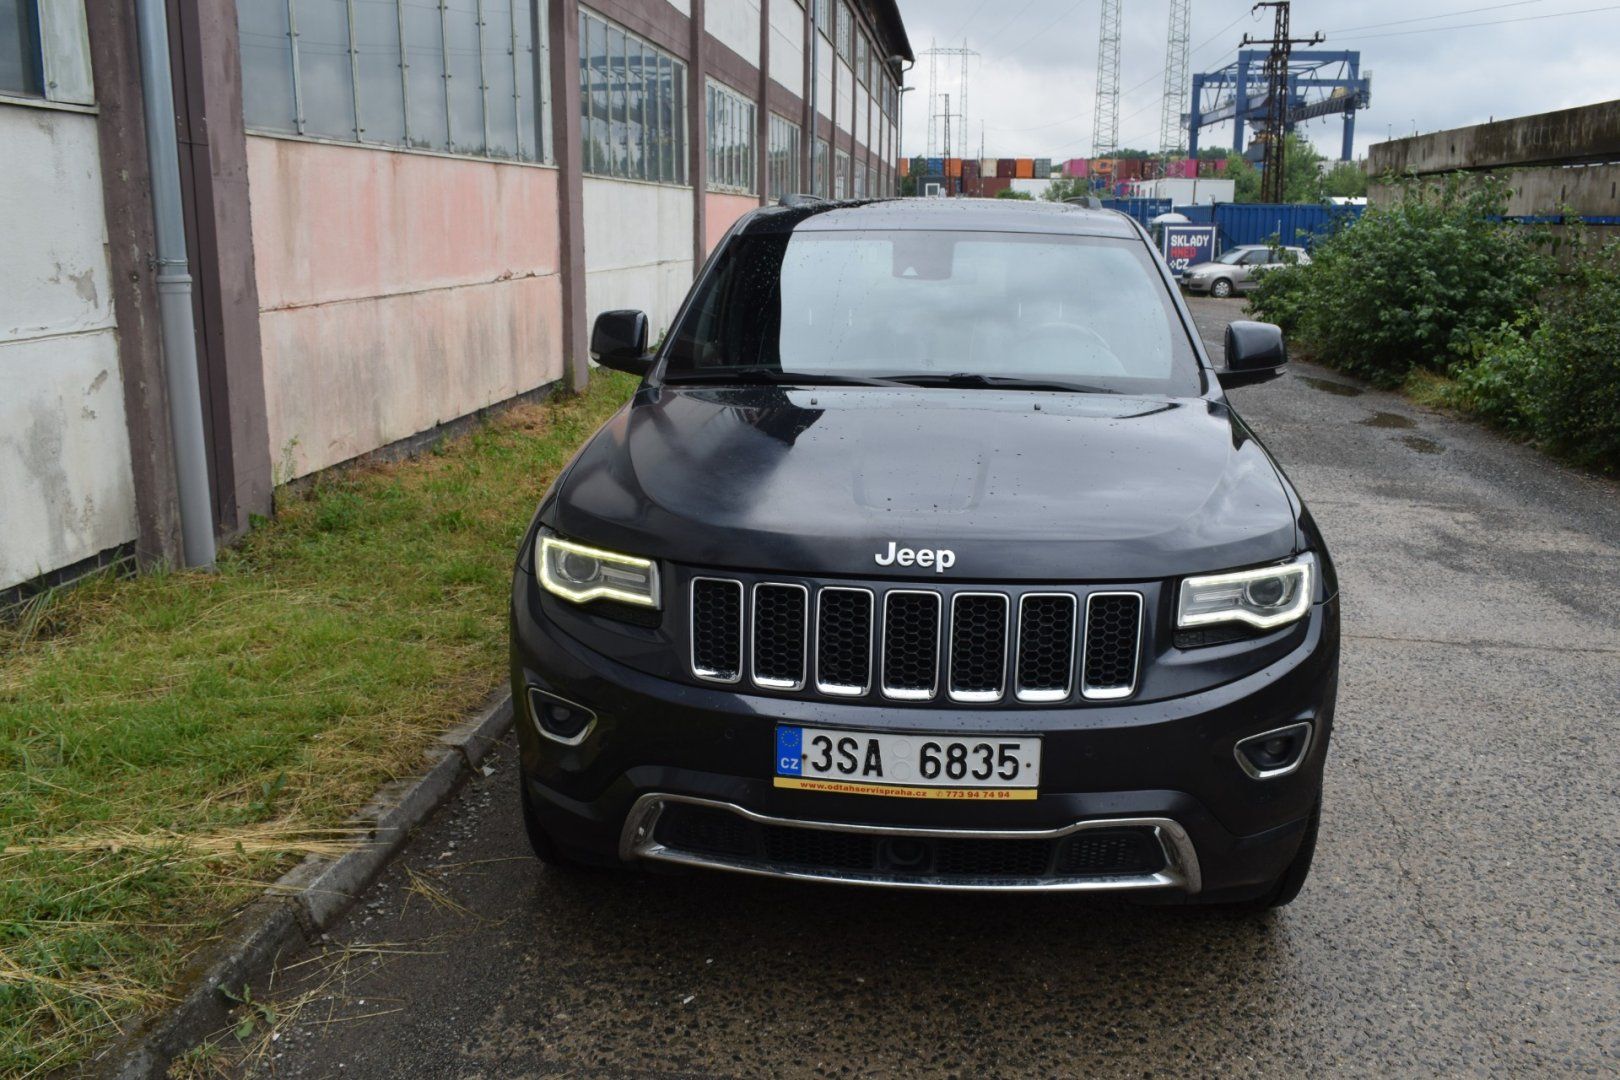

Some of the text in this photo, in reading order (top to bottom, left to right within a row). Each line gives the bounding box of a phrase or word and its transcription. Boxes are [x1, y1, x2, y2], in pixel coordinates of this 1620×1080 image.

[1170, 235, 1209, 247] SKLADY
[874, 541, 956, 573] Jeep
[780, 756, 799, 770] CZ
[811, 735, 1021, 781] 3SA 6835
[800, 781, 927, 797] www.odtahservispraha.cz
[967, 790, 979, 798] 94
